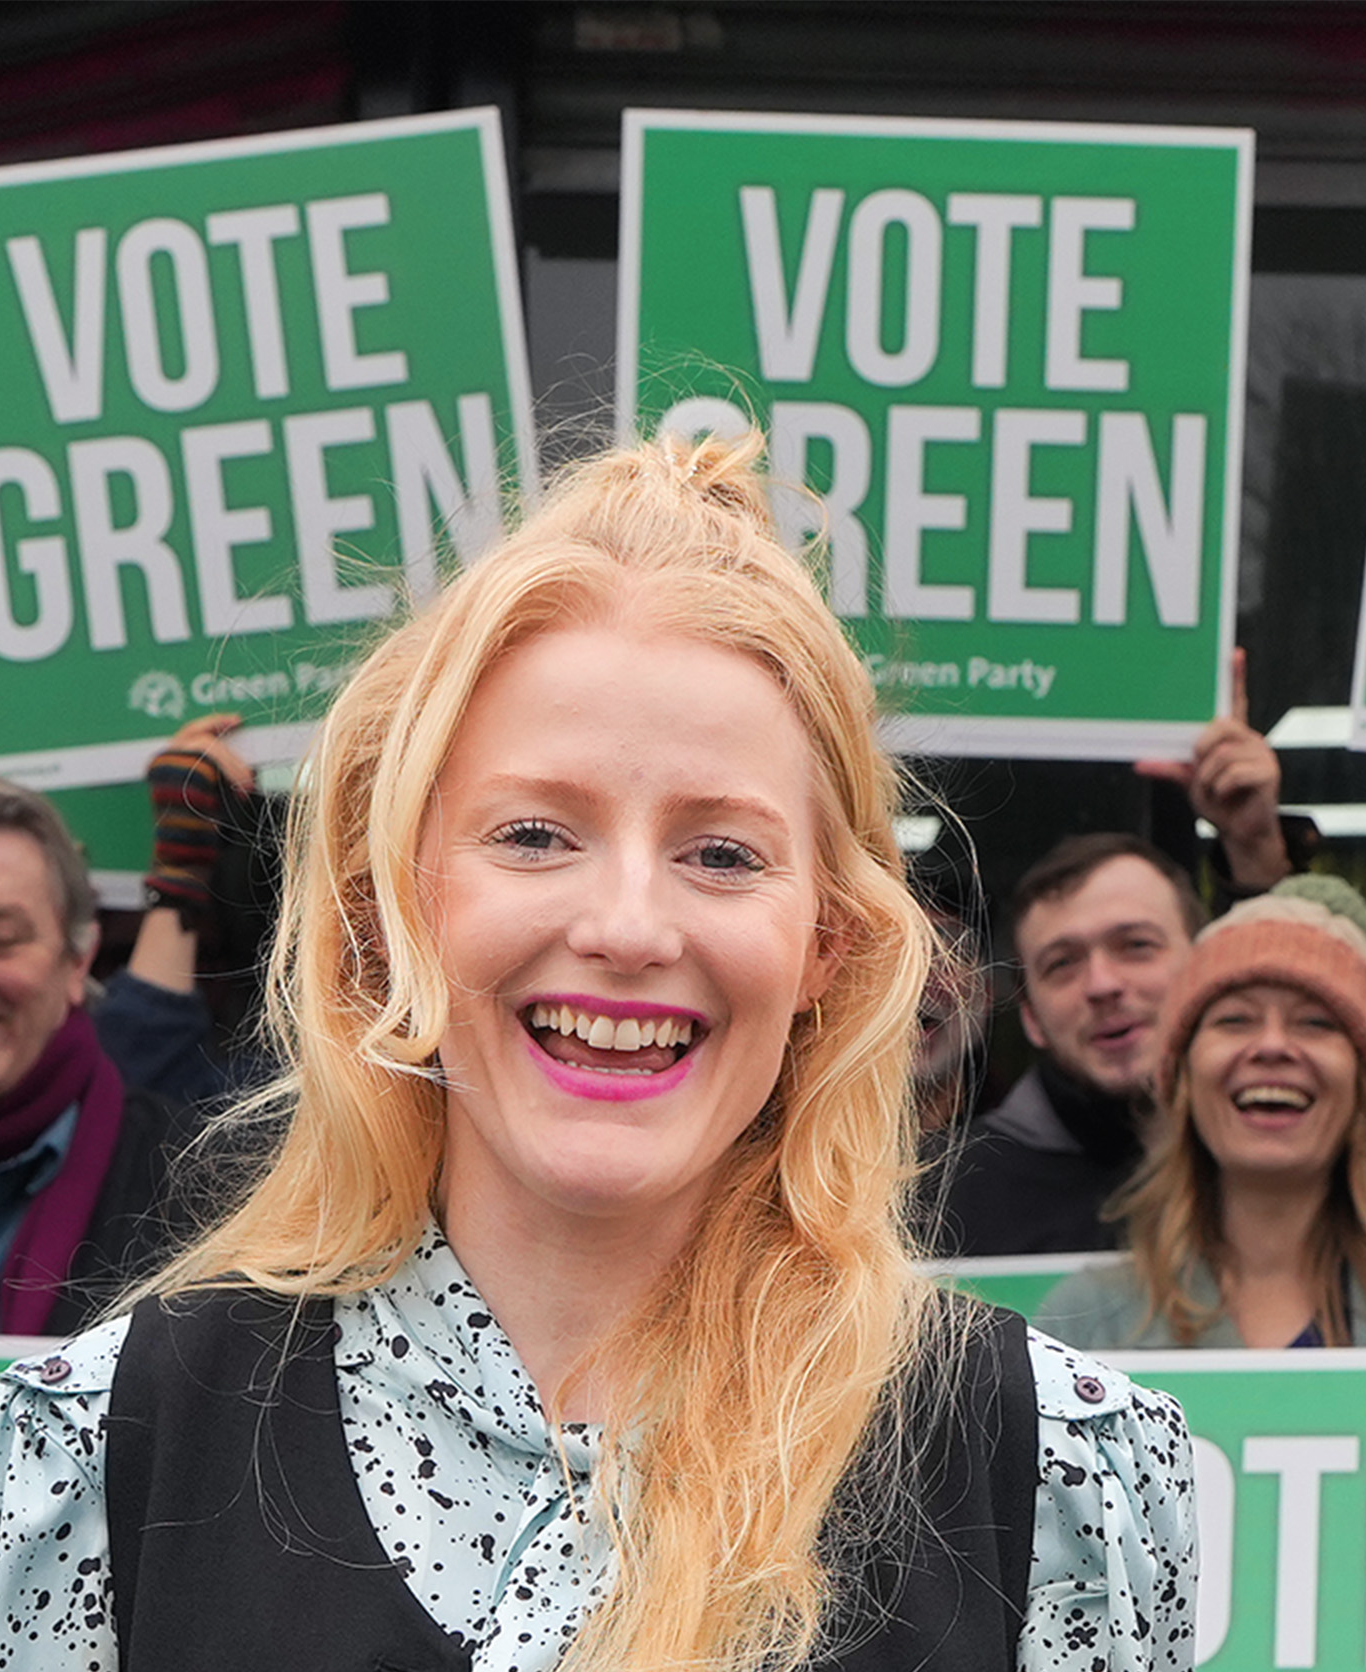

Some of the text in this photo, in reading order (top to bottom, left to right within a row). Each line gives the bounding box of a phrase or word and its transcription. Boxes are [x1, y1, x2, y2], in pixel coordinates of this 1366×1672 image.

[5, 192, 408, 426] VOTE
[739, 186, 1136, 392] VOTE
[656, 397, 1207, 627] REEN
[967, 656, 1056, 699] Party
